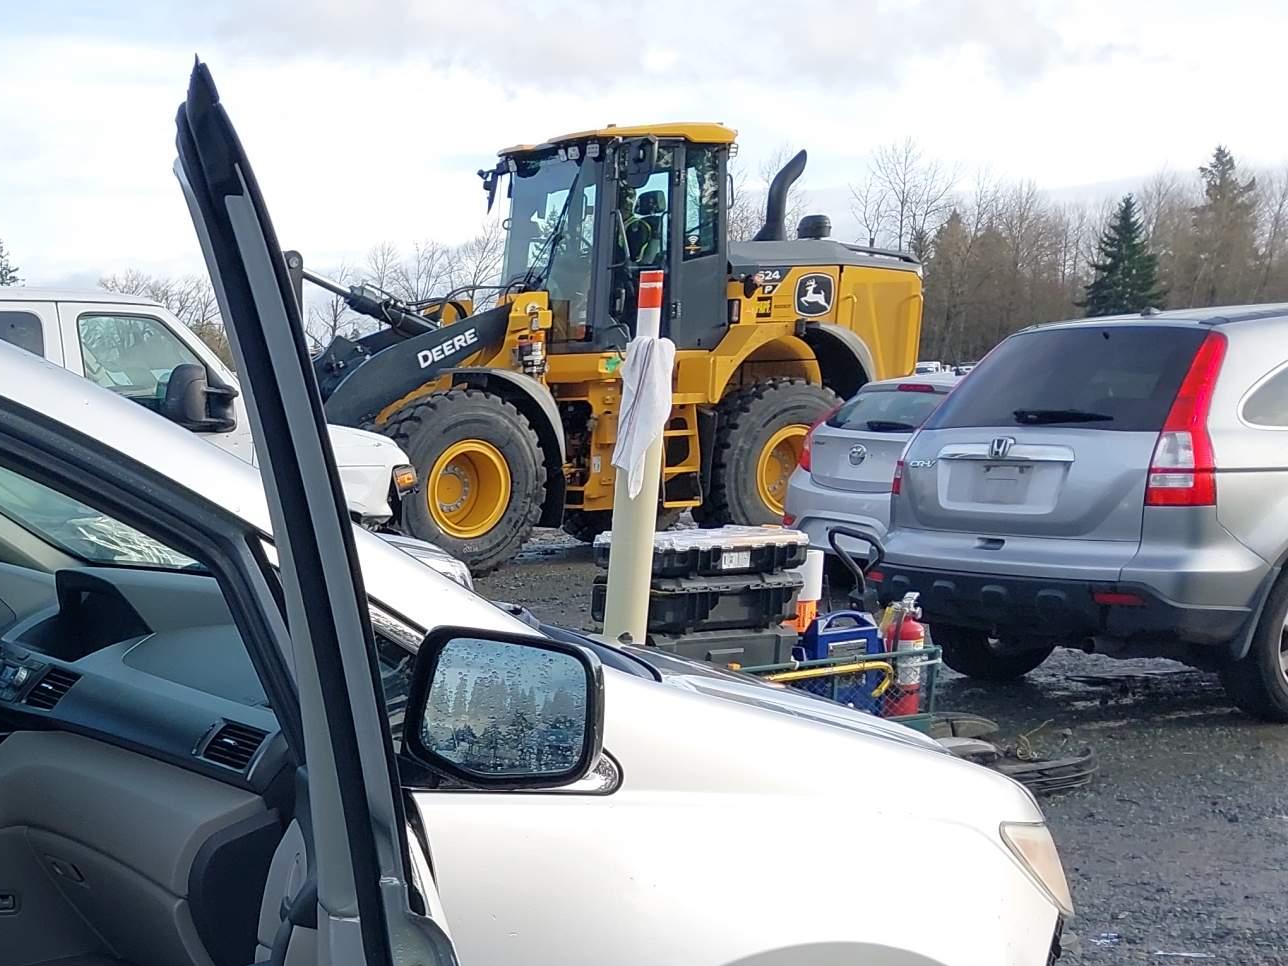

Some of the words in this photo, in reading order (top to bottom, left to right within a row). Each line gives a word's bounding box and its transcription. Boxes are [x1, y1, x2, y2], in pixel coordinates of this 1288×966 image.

[764, 285, 773, 294] P
[416, 327, 479, 369] DEERE
[910, 460, 936, 468] CR-V
